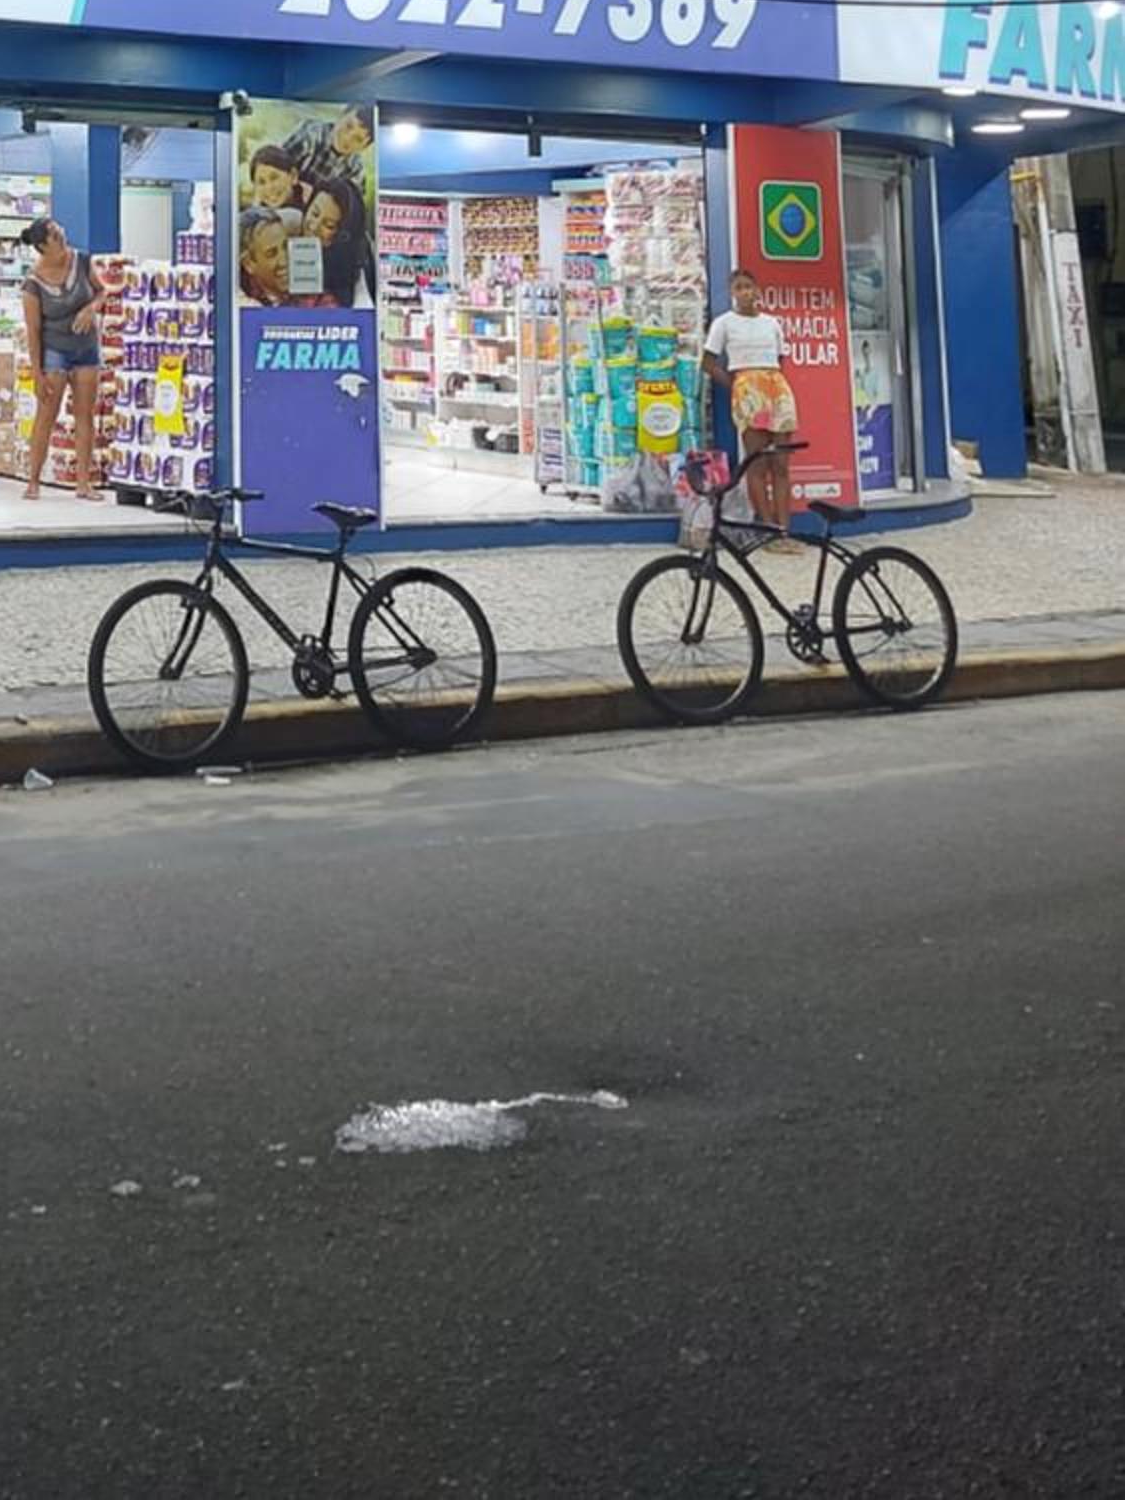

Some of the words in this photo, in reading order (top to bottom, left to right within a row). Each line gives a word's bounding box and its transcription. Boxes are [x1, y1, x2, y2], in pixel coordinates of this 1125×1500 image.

[754, 286, 796, 311] AQUI
[799, 286, 836, 310] TEM
[316, 325, 360, 341] LIDER
[777, 311, 839, 339] RMÁCIA
[255, 341, 362, 371] FARMA
[780, 342, 840, 365] PULAR
